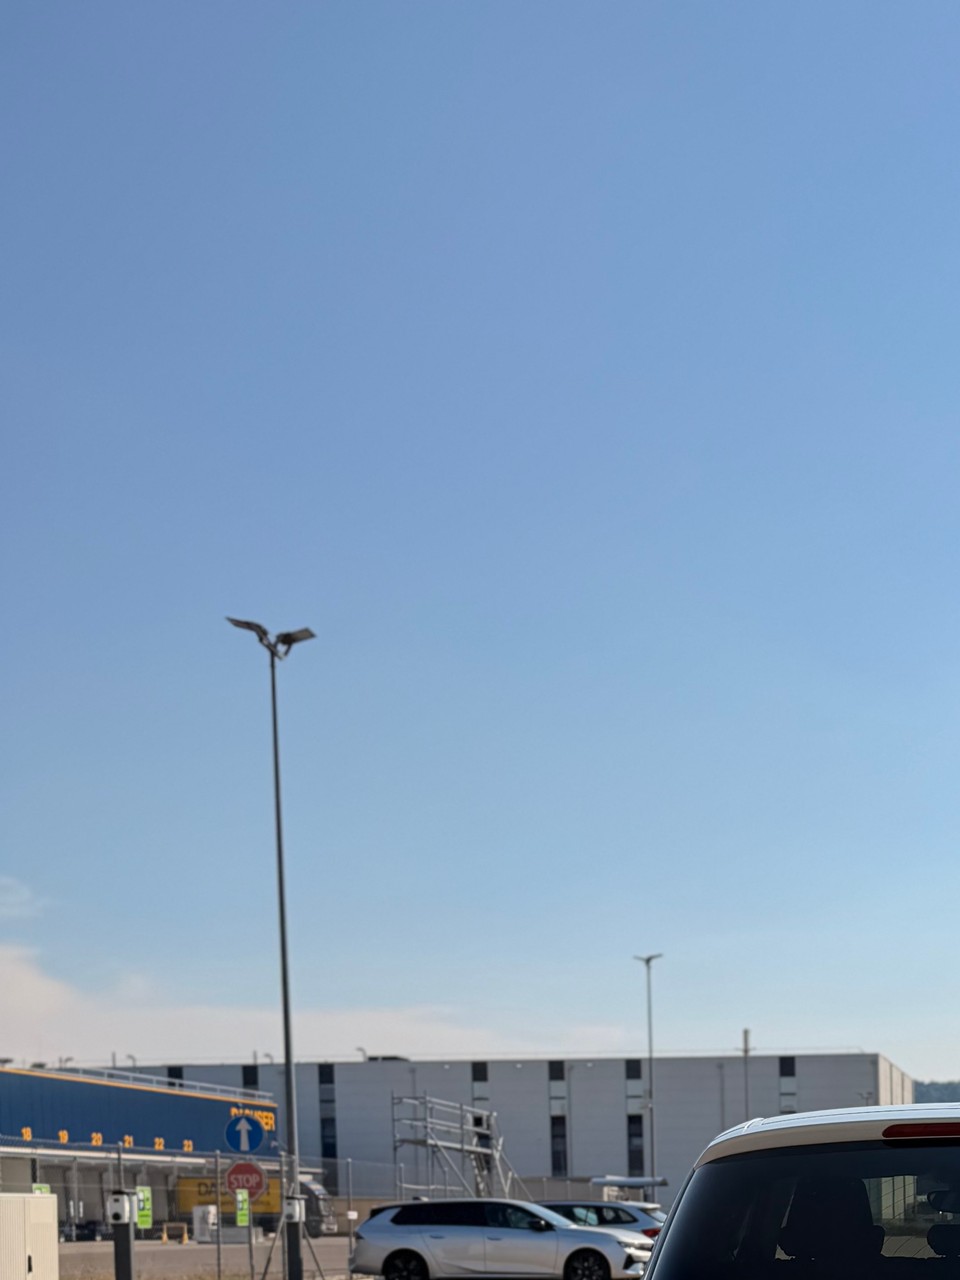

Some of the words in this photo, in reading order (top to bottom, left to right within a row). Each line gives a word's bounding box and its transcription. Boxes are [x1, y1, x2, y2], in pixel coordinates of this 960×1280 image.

[21, 1126, 32, 1142] 18
[58, 1129, 69, 1144] 19
[91, 1132, 103, 1146] 20
[123, 1135, 133, 1148] 21
[154, 1137, 164, 1151] 22
[183, 1140, 193, 1152] 23
[231, 1174, 259, 1188] STOP
